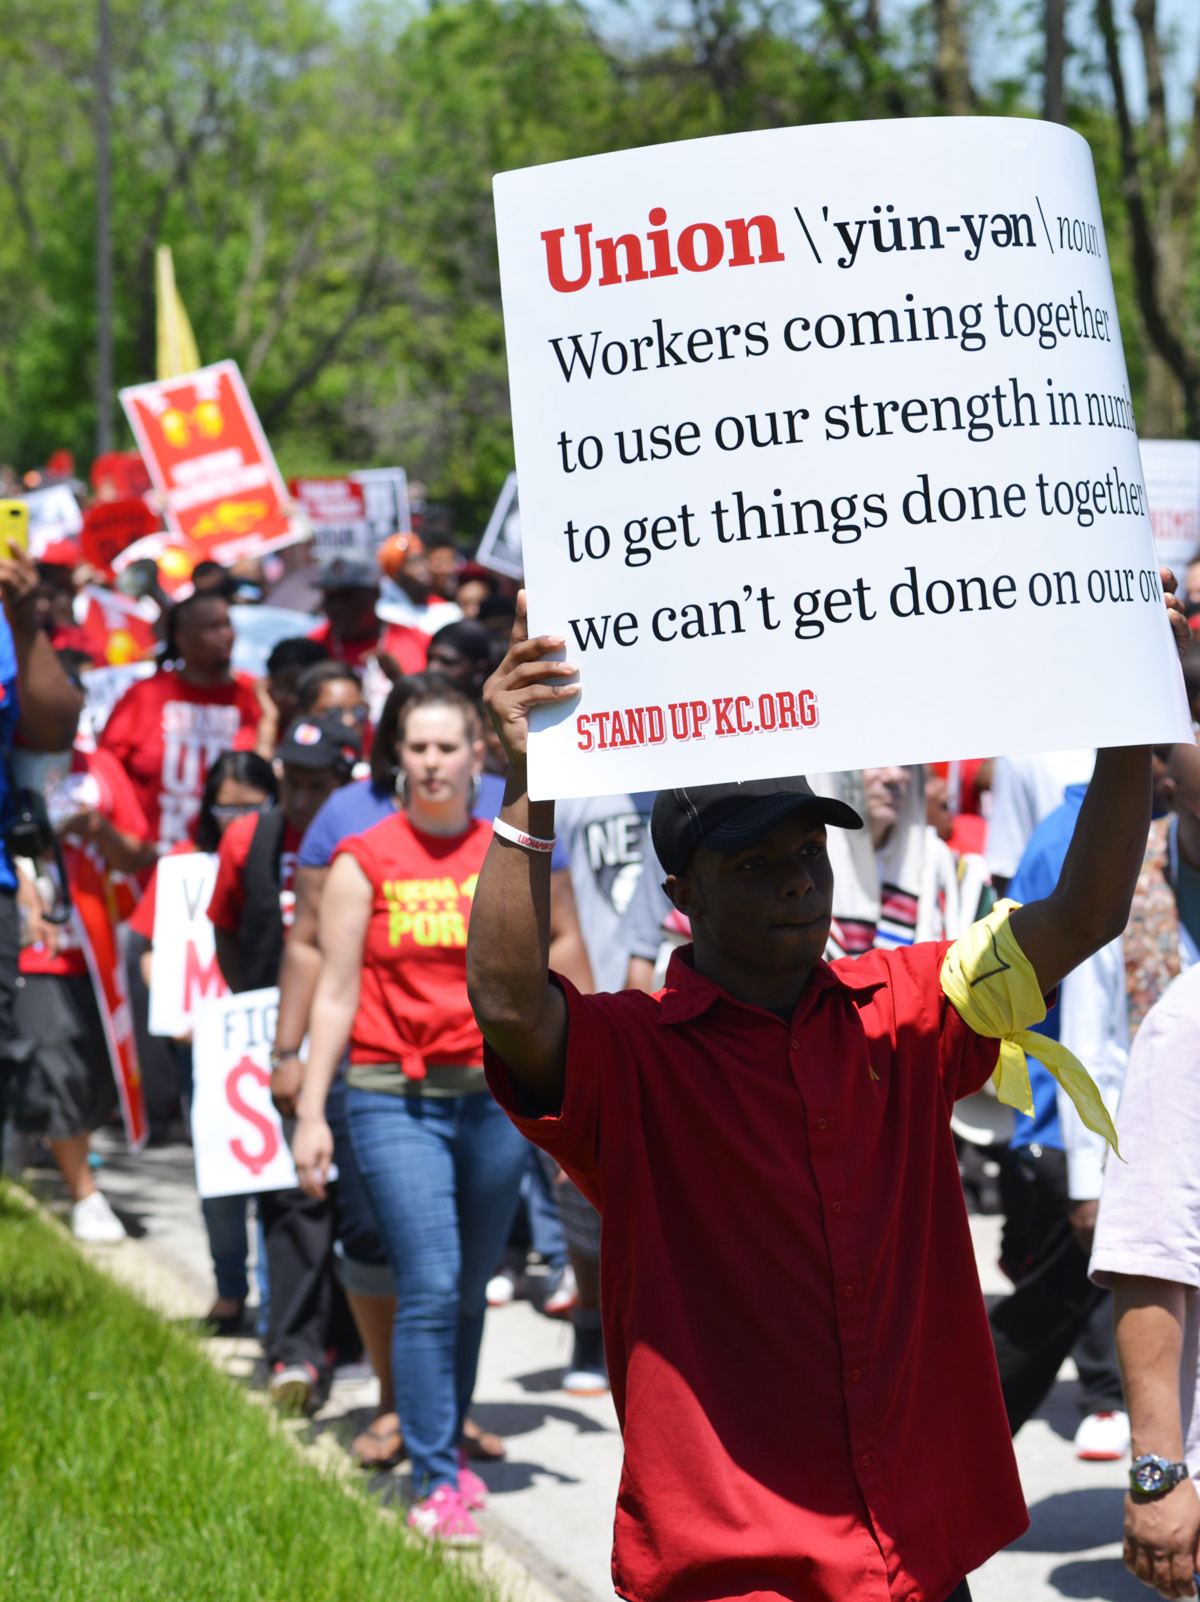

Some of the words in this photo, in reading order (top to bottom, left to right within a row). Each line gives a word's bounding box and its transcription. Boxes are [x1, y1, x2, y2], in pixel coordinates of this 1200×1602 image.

[540, 207, 786, 294] Union
[1056, 216, 1102, 259] noun
[549, 319, 769, 383] Workers
[783, 293, 986, 352] coming
[995, 290, 1111, 350] together
[557, 431, 604, 474] to
[615, 421, 701, 465] use
[715, 408, 810, 451] our
[824, 377, 1040, 443] strength
[1046, 378, 1082, 426] in
[563, 519, 611, 563] to
[624, 504, 701, 568] get
[711, 487, 888, 546] things
[902, 473, 1027, 531] done
[1036, 466, 1145, 529] together
[568, 612, 639, 652] we
[653, 584, 781, 643] can't
[793, 577, 877, 641] get
[889, 565, 1017, 619] done
[1028, 570, 1081, 608] on
[1088, 569, 1134, 603] our
[576, 705, 666, 753] STAND
[668, 698, 710, 741] UP
[713, 689, 819, 738] KC.ORG
[586, 813, 645, 871] NE
